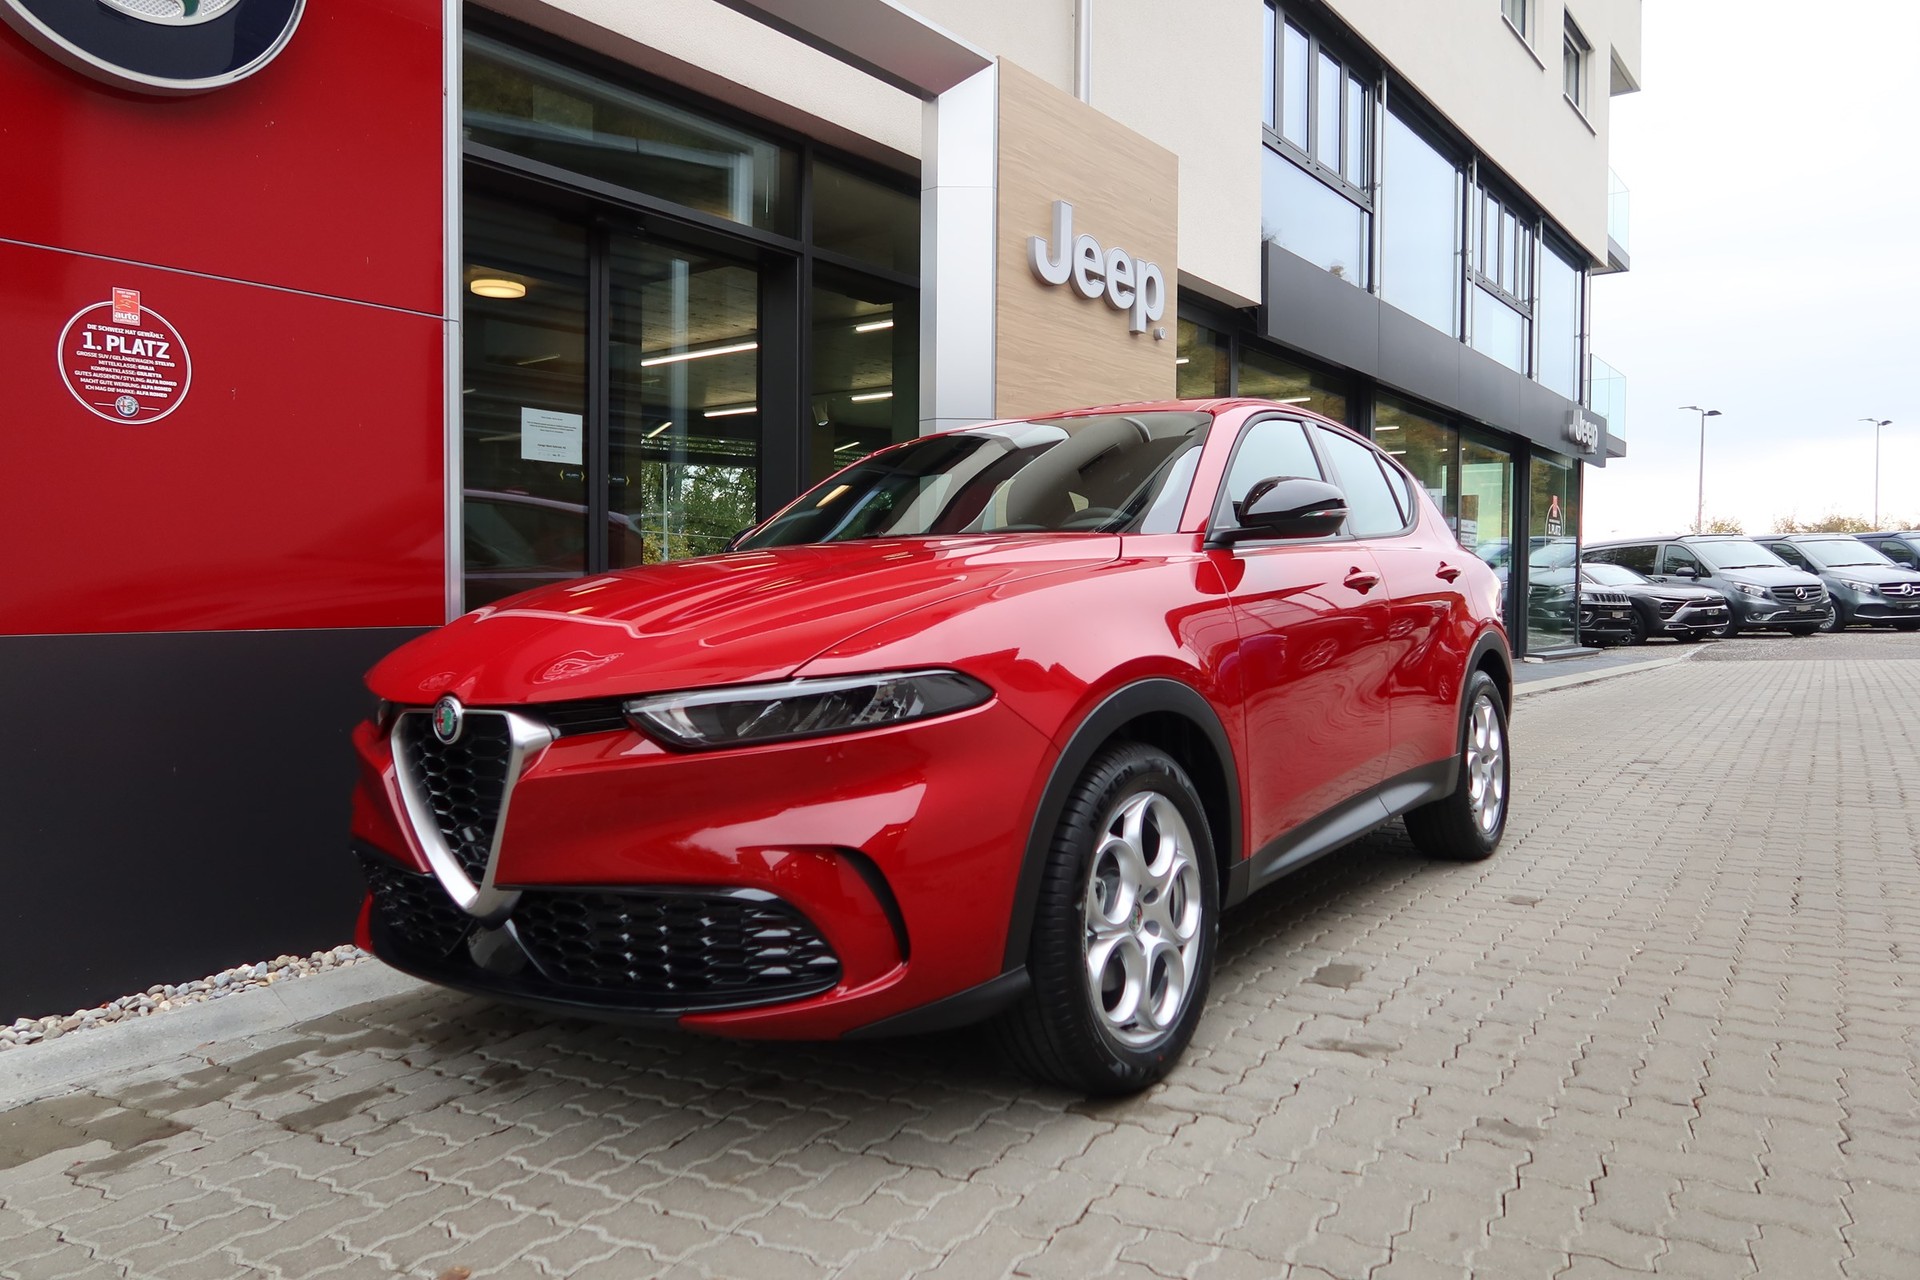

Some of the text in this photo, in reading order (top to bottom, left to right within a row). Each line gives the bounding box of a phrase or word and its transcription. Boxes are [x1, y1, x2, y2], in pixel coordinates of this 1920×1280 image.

[1027, 200, 1165, 335] Jeep
[115, 311, 138, 321] auto
[98, 325, 124, 334] SCHWEIZ
[76, 350, 97, 358] GROSSE
[82, 331, 170, 359] 1. PLATZ
[1568, 410, 1598, 453] Jeep
